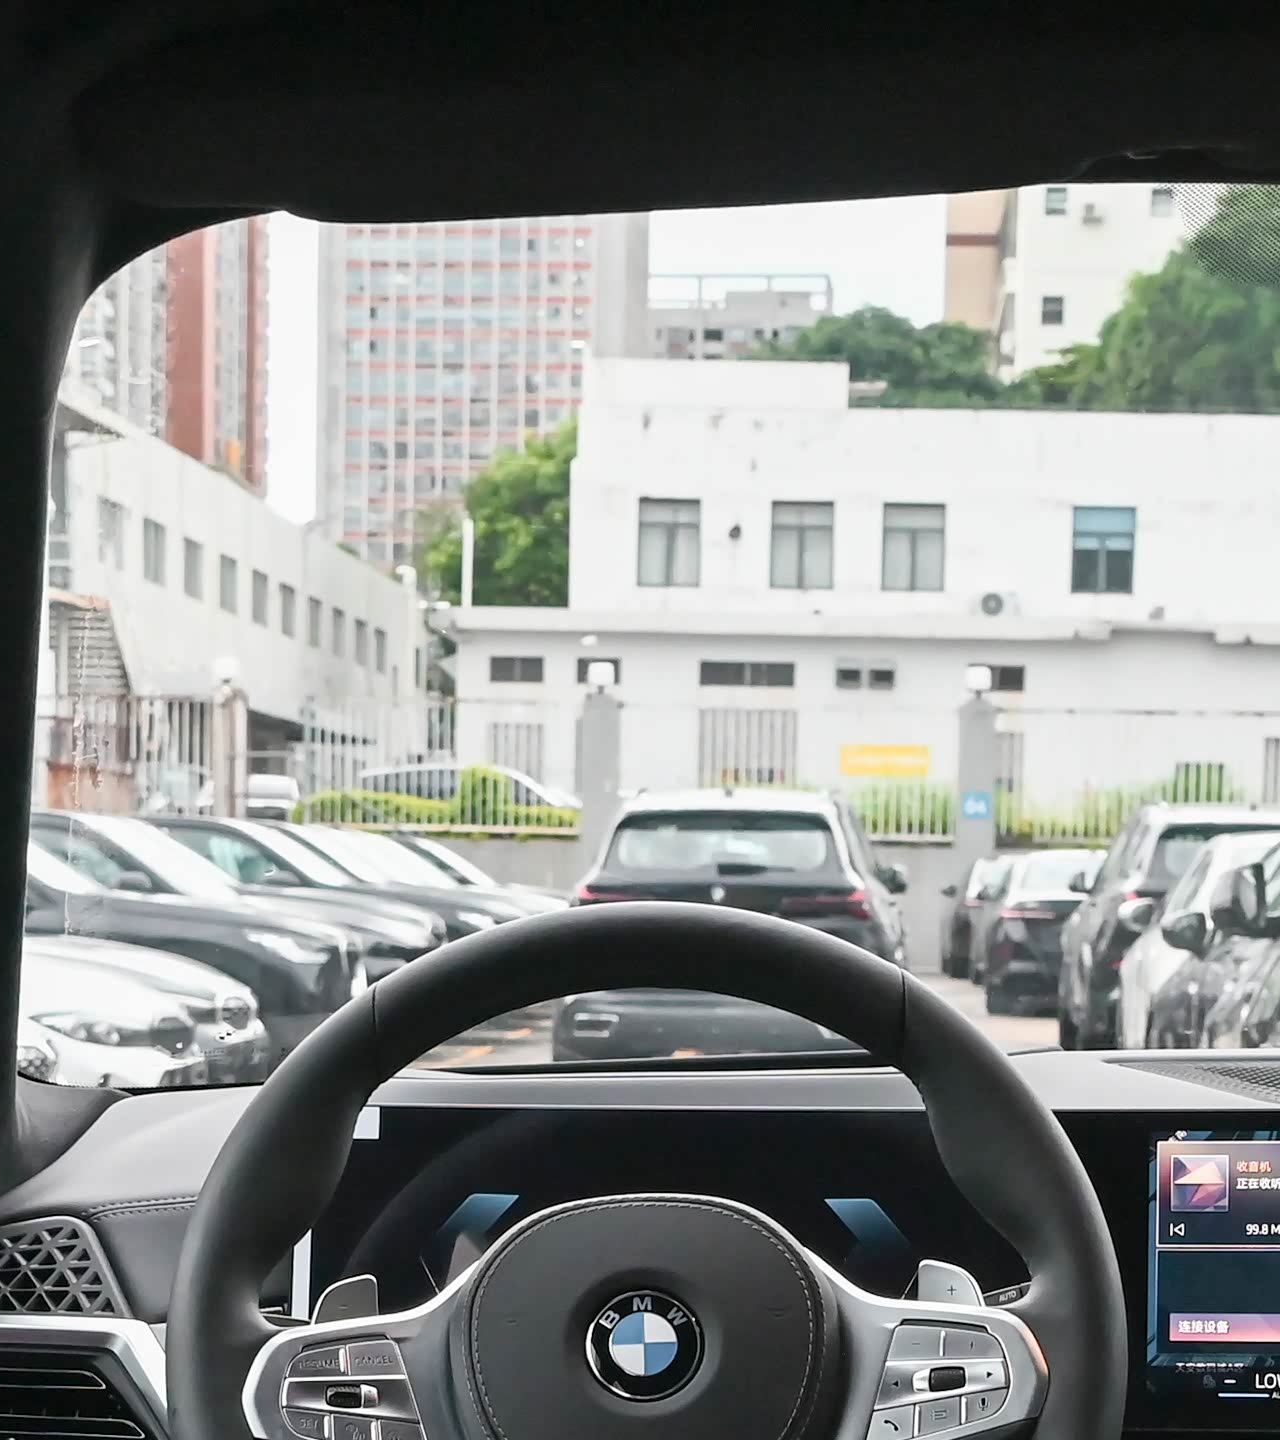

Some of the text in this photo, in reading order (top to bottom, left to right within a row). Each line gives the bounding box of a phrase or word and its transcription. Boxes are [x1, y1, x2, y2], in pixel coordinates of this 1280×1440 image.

[1236, 1161, 1272, 1173] 收音机
[1245, 1223, 1269, 1236] 99.8
[599, 1297, 688, 1329] BMW
[1178, 1320, 1230, 1334] 连接设备
